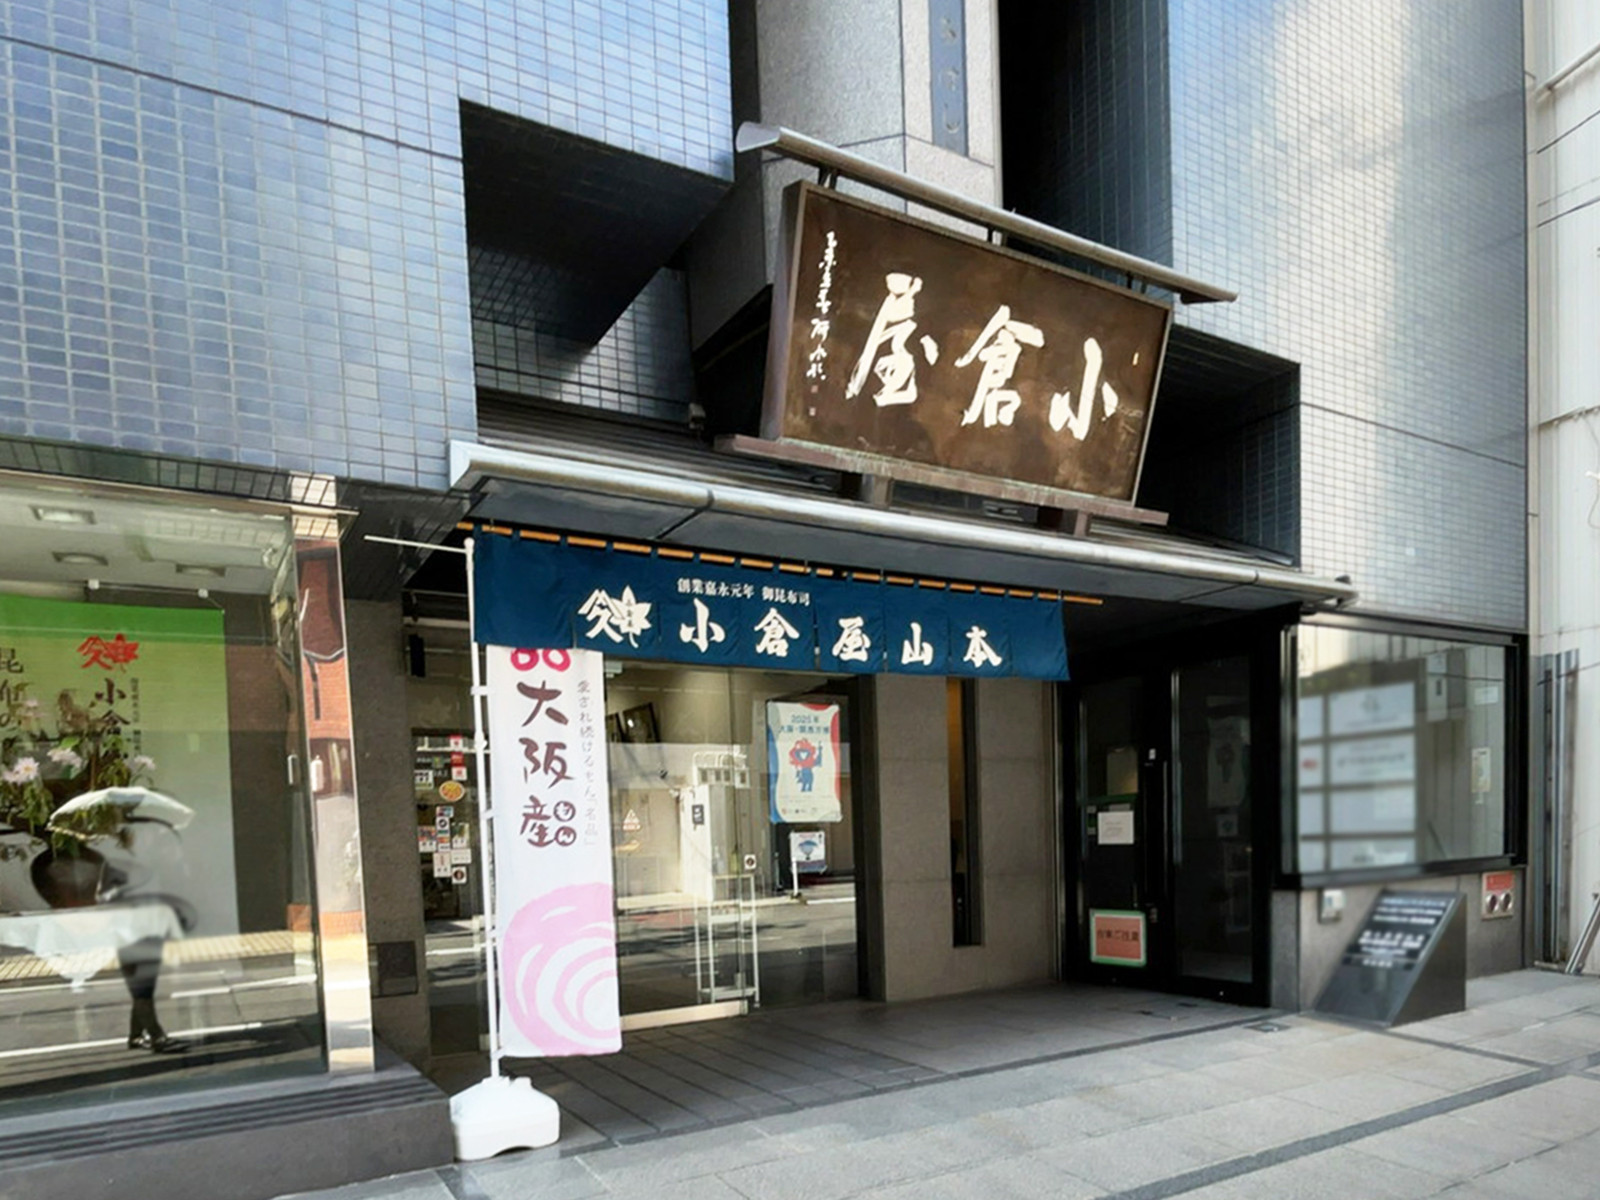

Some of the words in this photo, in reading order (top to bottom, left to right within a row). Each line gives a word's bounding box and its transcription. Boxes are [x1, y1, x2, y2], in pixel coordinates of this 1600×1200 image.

[845, 272, 1119, 442] 小倉屋
[679, 597, 1003, 668] 小倉屋山本
